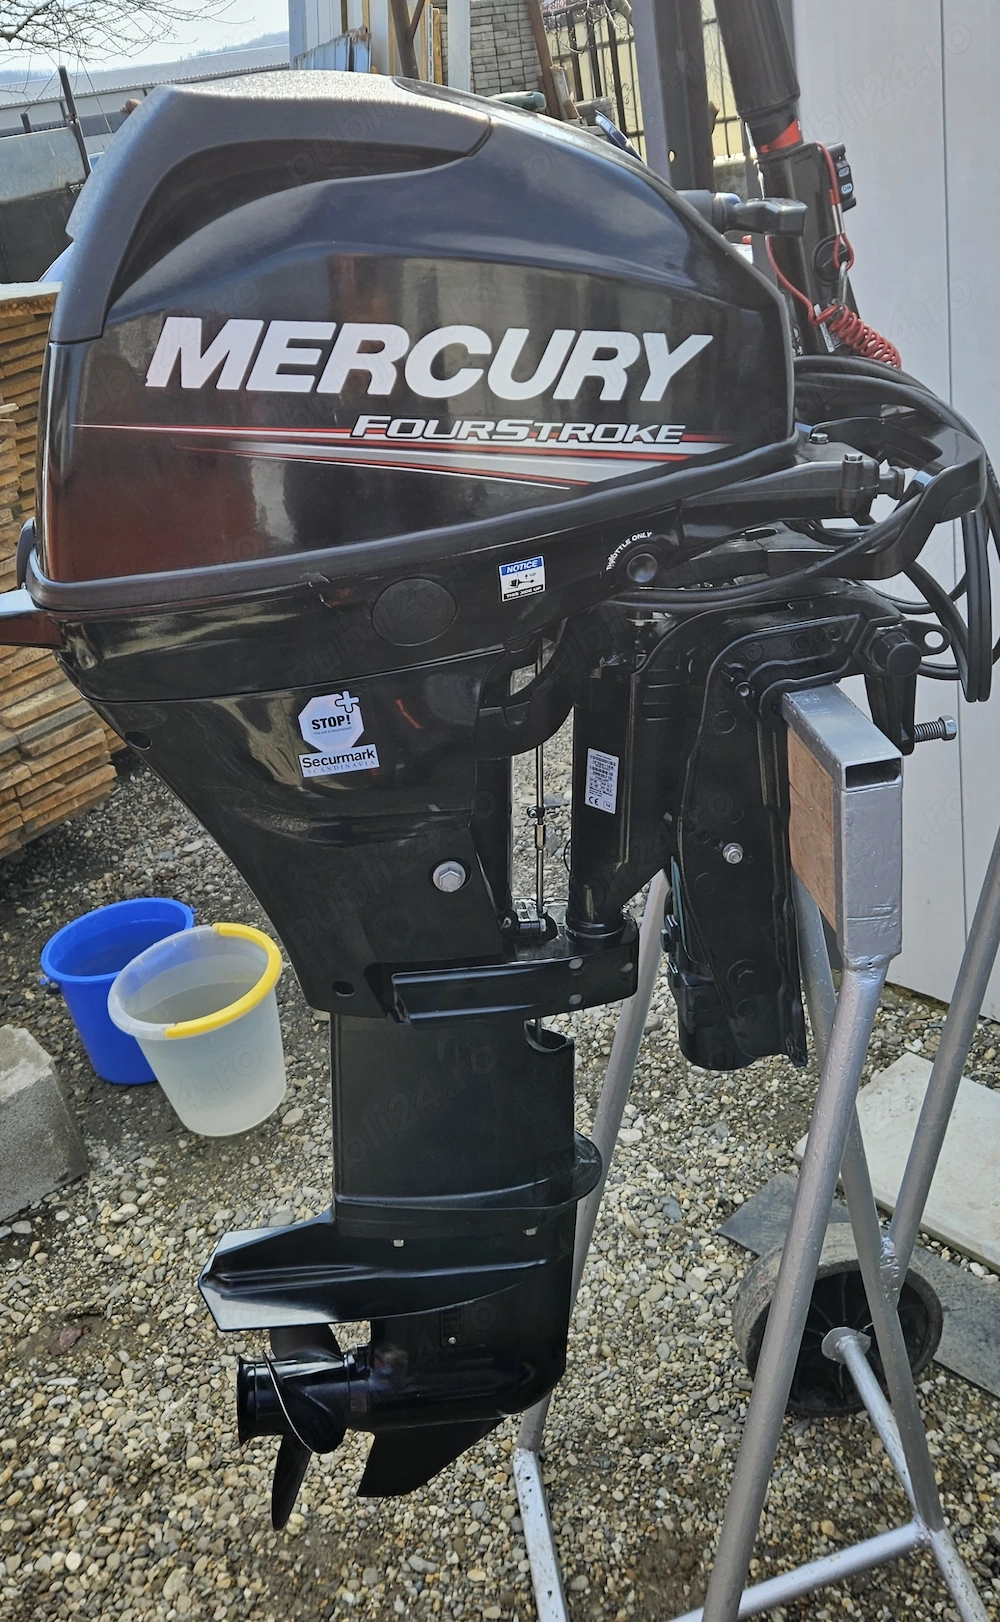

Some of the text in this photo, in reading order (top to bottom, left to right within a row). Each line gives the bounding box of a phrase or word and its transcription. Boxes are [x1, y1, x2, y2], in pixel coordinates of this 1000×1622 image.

[145, 316, 714, 402] MERCURY
[606, 531, 653, 571] THROTTLE ONLY
[506, 559, 539, 573] NOTICE
[311, 714, 351, 730] STOP!
[302, 748, 376, 768] Securmark
[307, 760, 376, 774] SCANDINAVIA
